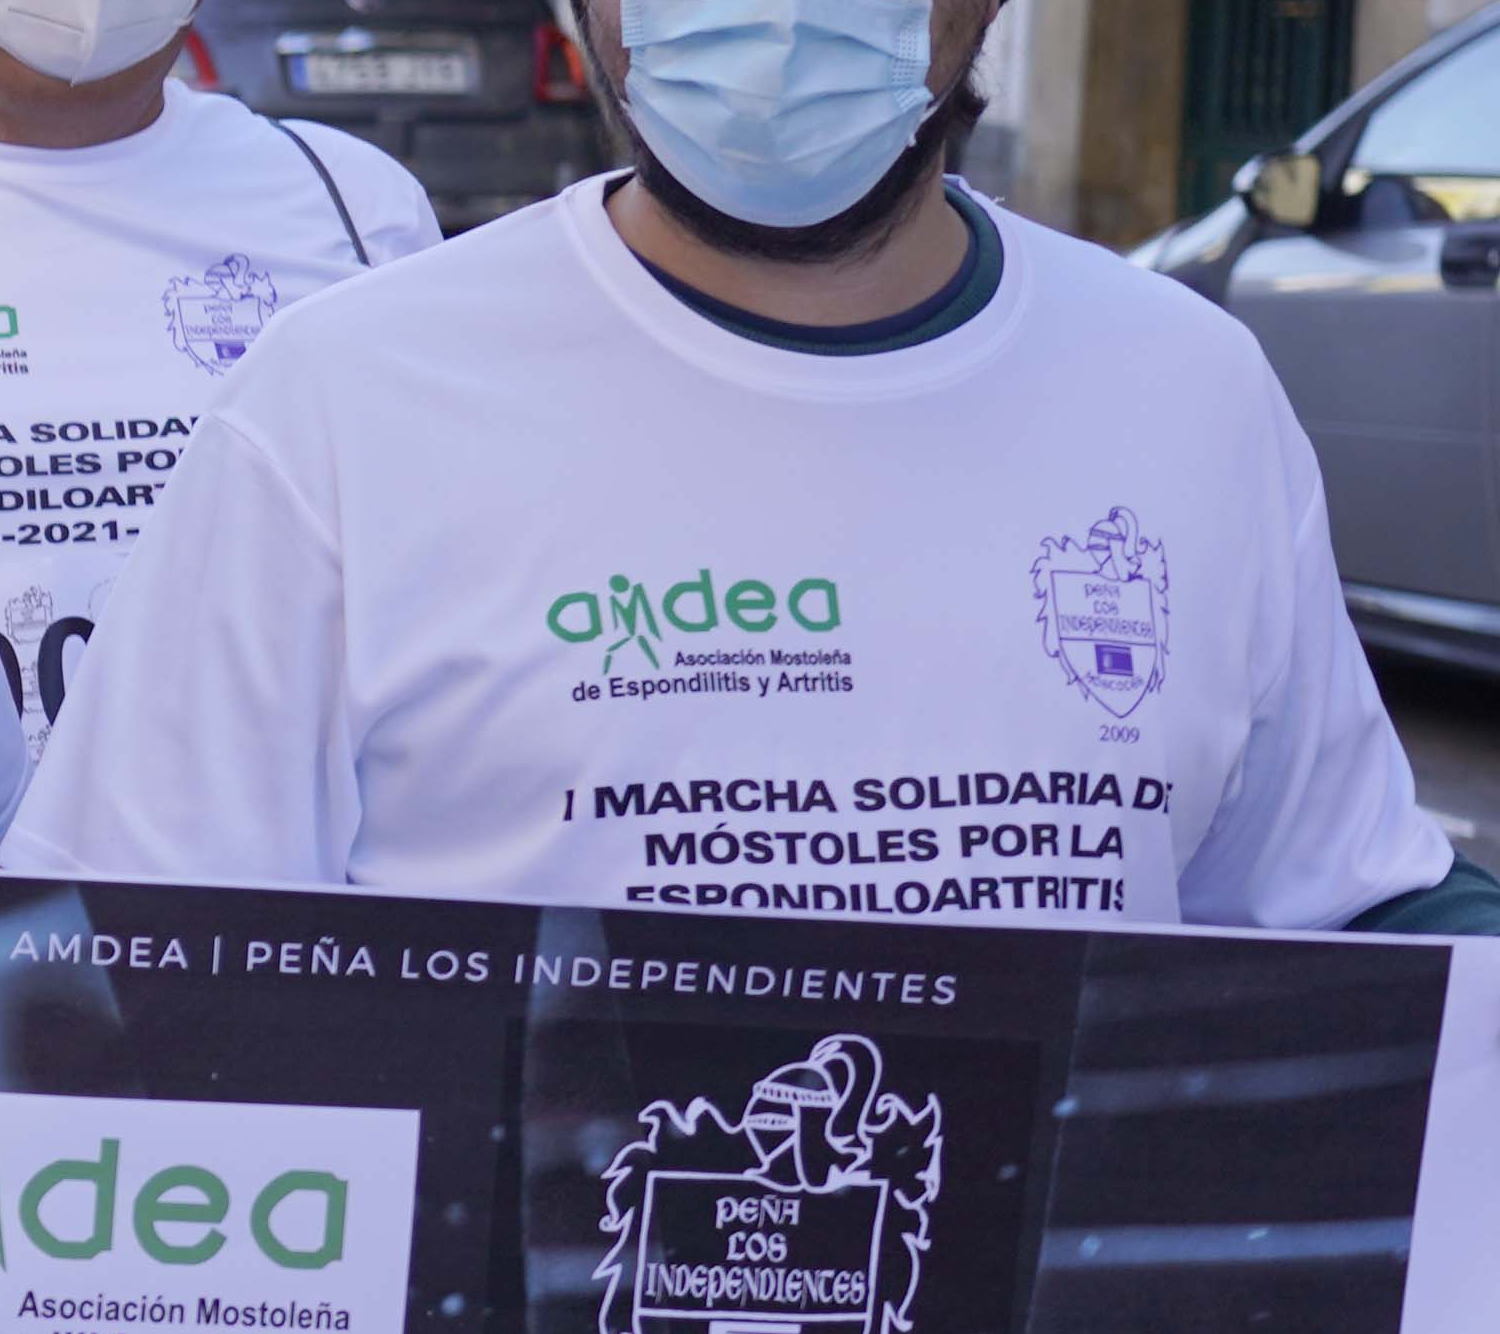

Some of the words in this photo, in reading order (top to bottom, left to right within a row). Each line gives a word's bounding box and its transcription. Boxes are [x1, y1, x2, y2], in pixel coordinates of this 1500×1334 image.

[30, 416, 199, 445] SOLIDA
[117, 446, 185, 474] PO
[674, 648, 765, 669] Asociación
[770, 646, 853, 667] Mostoleña
[572, 680, 601, 703] de
[608, 671, 751, 702] Espondilitis
[756, 677, 772, 698] y
[777, 671, 854, 694] Artritis
[1099, 723, 1141, 744] 2009
[562, 789, 575, 822] I
[593, 778, 838, 819] MARCHA
[853, 770, 1125, 814] SOLIDARIA
[644, 823, 939, 867] MÓSTOLES
[960, 824, 1057, 859] POR
[1070, 824, 1124, 860] LA
[11, 930, 188, 969] AMDEA
[246, 937, 377, 978] PEÑA
[401, 949, 490, 982] LOS
[514, 953, 958, 1005] INDEPENDIENTES
[715, 1194, 802, 1227] PEÑA
[645, 1262, 866, 1308] INDEPENDIENTES
[18, 1291, 185, 1326] Asociación
[196, 1296, 351, 1331] Mostoleña
